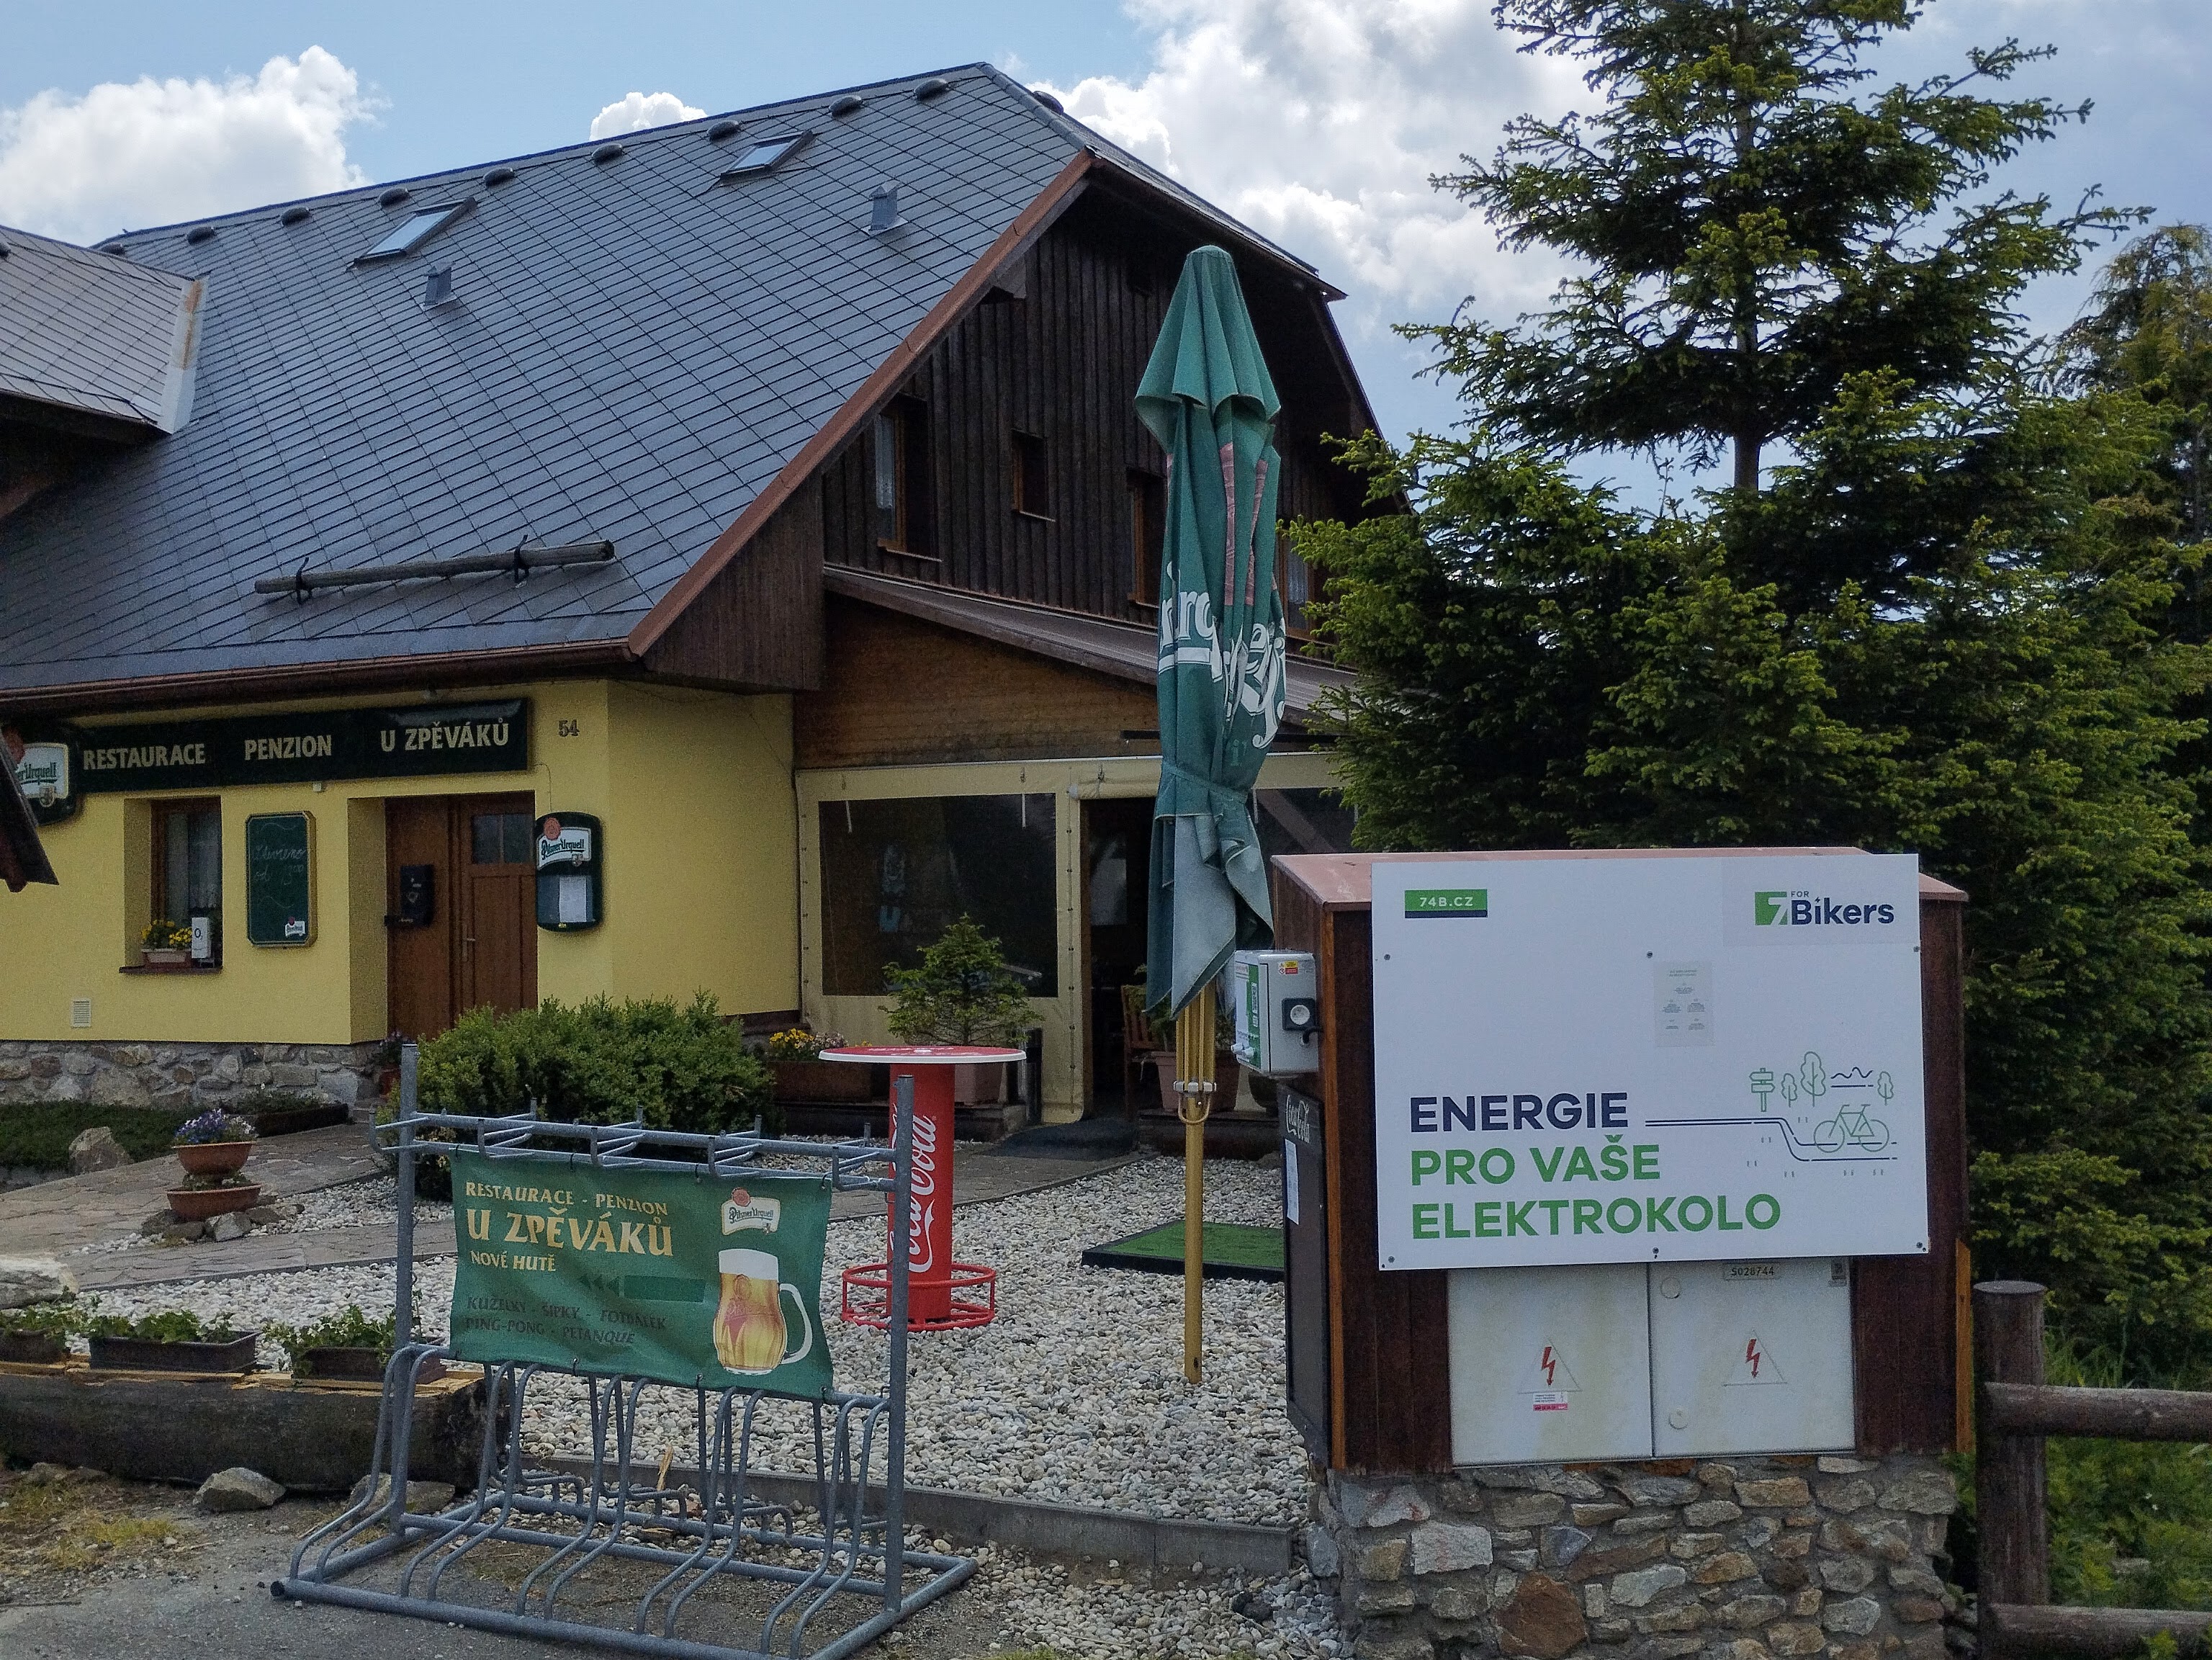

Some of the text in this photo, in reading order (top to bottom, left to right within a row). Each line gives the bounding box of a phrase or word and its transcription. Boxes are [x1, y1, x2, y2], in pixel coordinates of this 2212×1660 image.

[83, 717, 509, 770] RESTAURACE PENZION U ZPĚVÁKŮ
[558, 719, 580, 737] 54
[1419, 896, 1473, 907] 74B.CZ
[1791, 896, 1894, 925] Bikers
[1410, 1092, 1629, 1132] ENERGIE
[1411, 1134, 1661, 1186] PRO VAŠE
[466, 1182, 668, 1216] RESTAURACE PENZION
[1412, 1193, 1781, 1239] ELEKTROKOLO
[467, 1206, 673, 1256] U ZPĚVÁKŮ
[470, 1250, 557, 1272] NOVÉ HUTĚ
